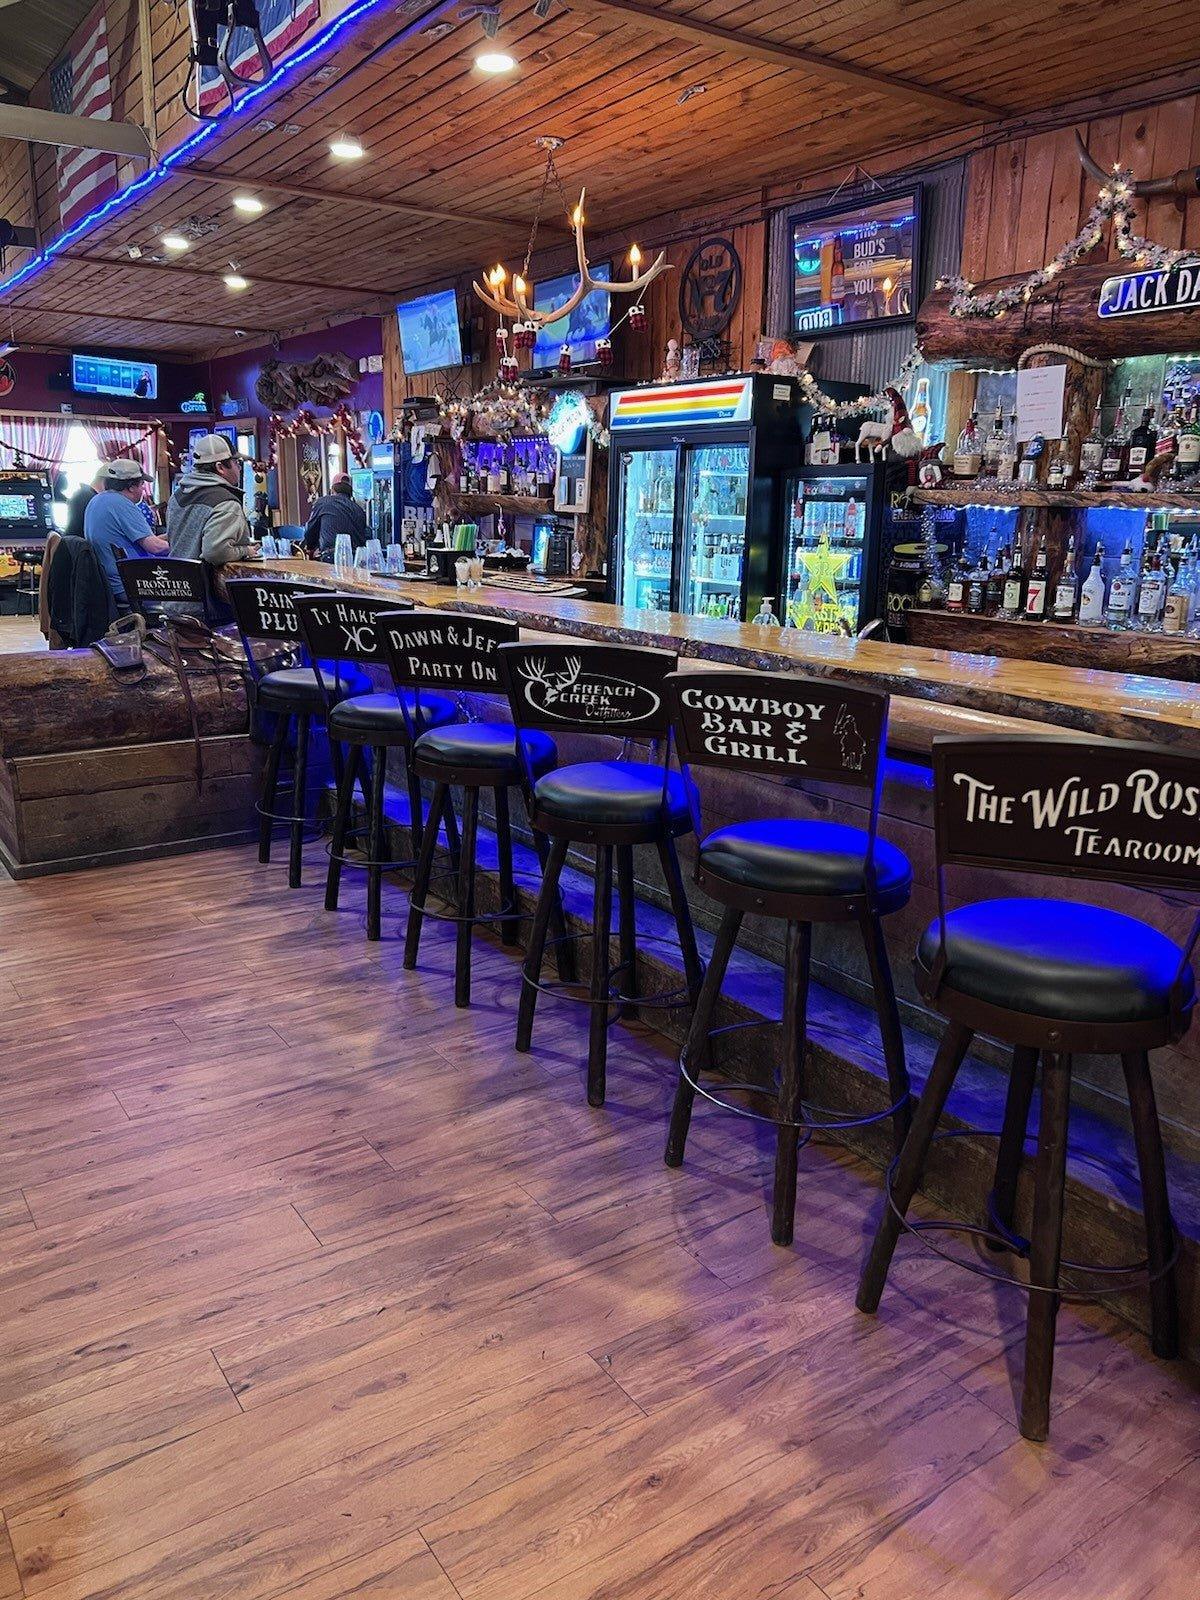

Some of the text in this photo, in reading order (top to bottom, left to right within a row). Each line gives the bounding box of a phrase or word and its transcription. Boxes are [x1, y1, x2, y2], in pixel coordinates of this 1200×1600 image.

[853, 238, 885, 258] BUD'S
[1108, 272, 1170, 312] JACK
[136, 579, 191, 590] FRONTIER
[255, 588, 304, 610] PAIN
[1027, 588, 1041, 611] 7
[310, 603, 377, 626] TY HAKE
[389, 629, 443, 650] DAWN
[447, 625, 460, 646] &
[408, 656, 497, 682] PARTY ON
[560, 692, 611, 706] CREEK
[573, 683, 636, 698] FRENCH
[681, 688, 826, 721] COWBOY
[701, 712, 808, 744] BAR &
[704, 735, 808, 766] GRILL
[953, 772, 1016, 825] THE
[1021, 776, 1120, 829] WILD
[1064, 826, 1200, 865] TEAROOM
